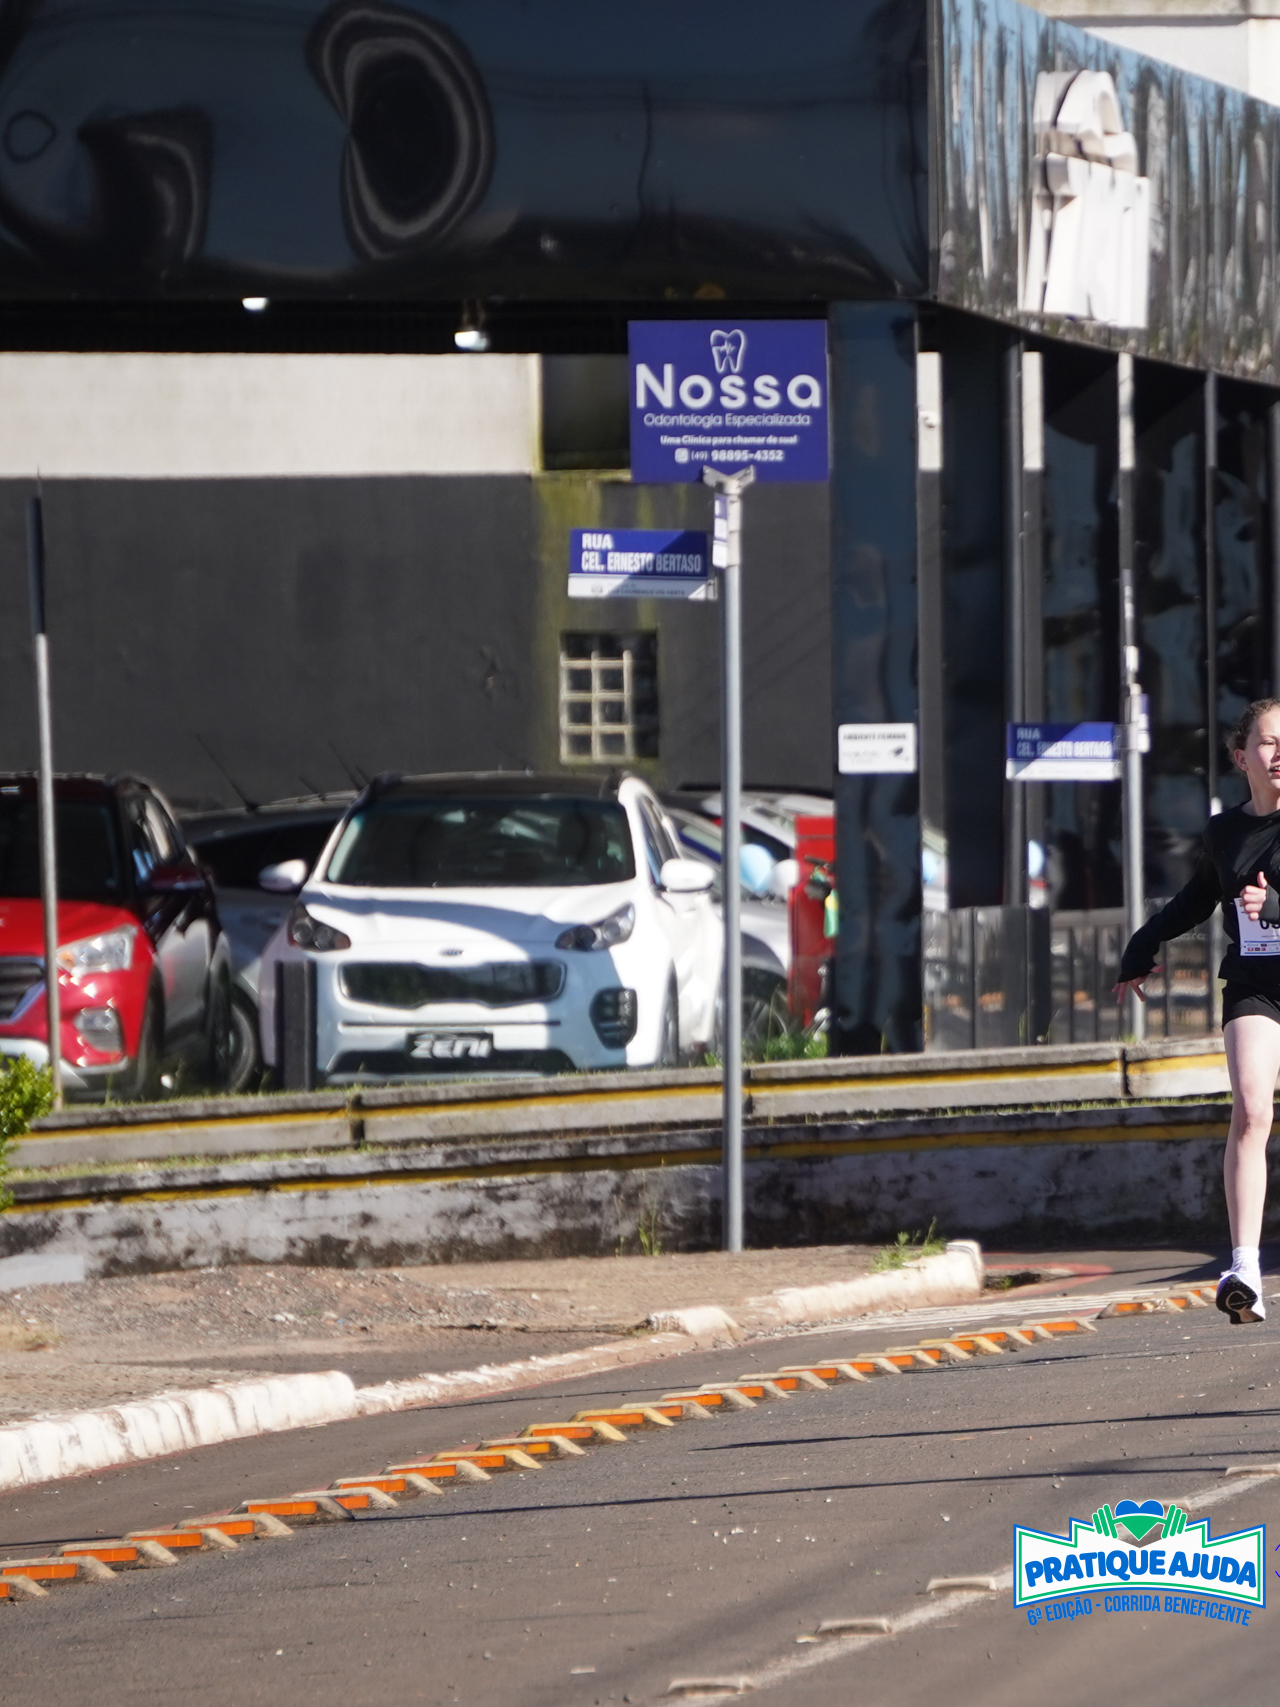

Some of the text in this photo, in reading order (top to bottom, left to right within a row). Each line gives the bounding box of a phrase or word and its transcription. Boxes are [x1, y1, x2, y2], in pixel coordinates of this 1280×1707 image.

[636, 363, 821, 409] Nossa
[644, 413, 811, 429] Odontologia Especializada
[660, 435, 680, 444] Uma
[712, 437, 732, 446] para
[733, 434, 765, 444] chamar
[766, 434, 777, 444] de
[582, 533, 613, 549] RUA
[582, 552, 701, 573] CEL. ERNESTO BERTASO
[1017, 727, 1041, 740] RUA
[1037, 741, 1073, 757] ERNESTO
[1074, 741, 1112, 757] BERTASO
